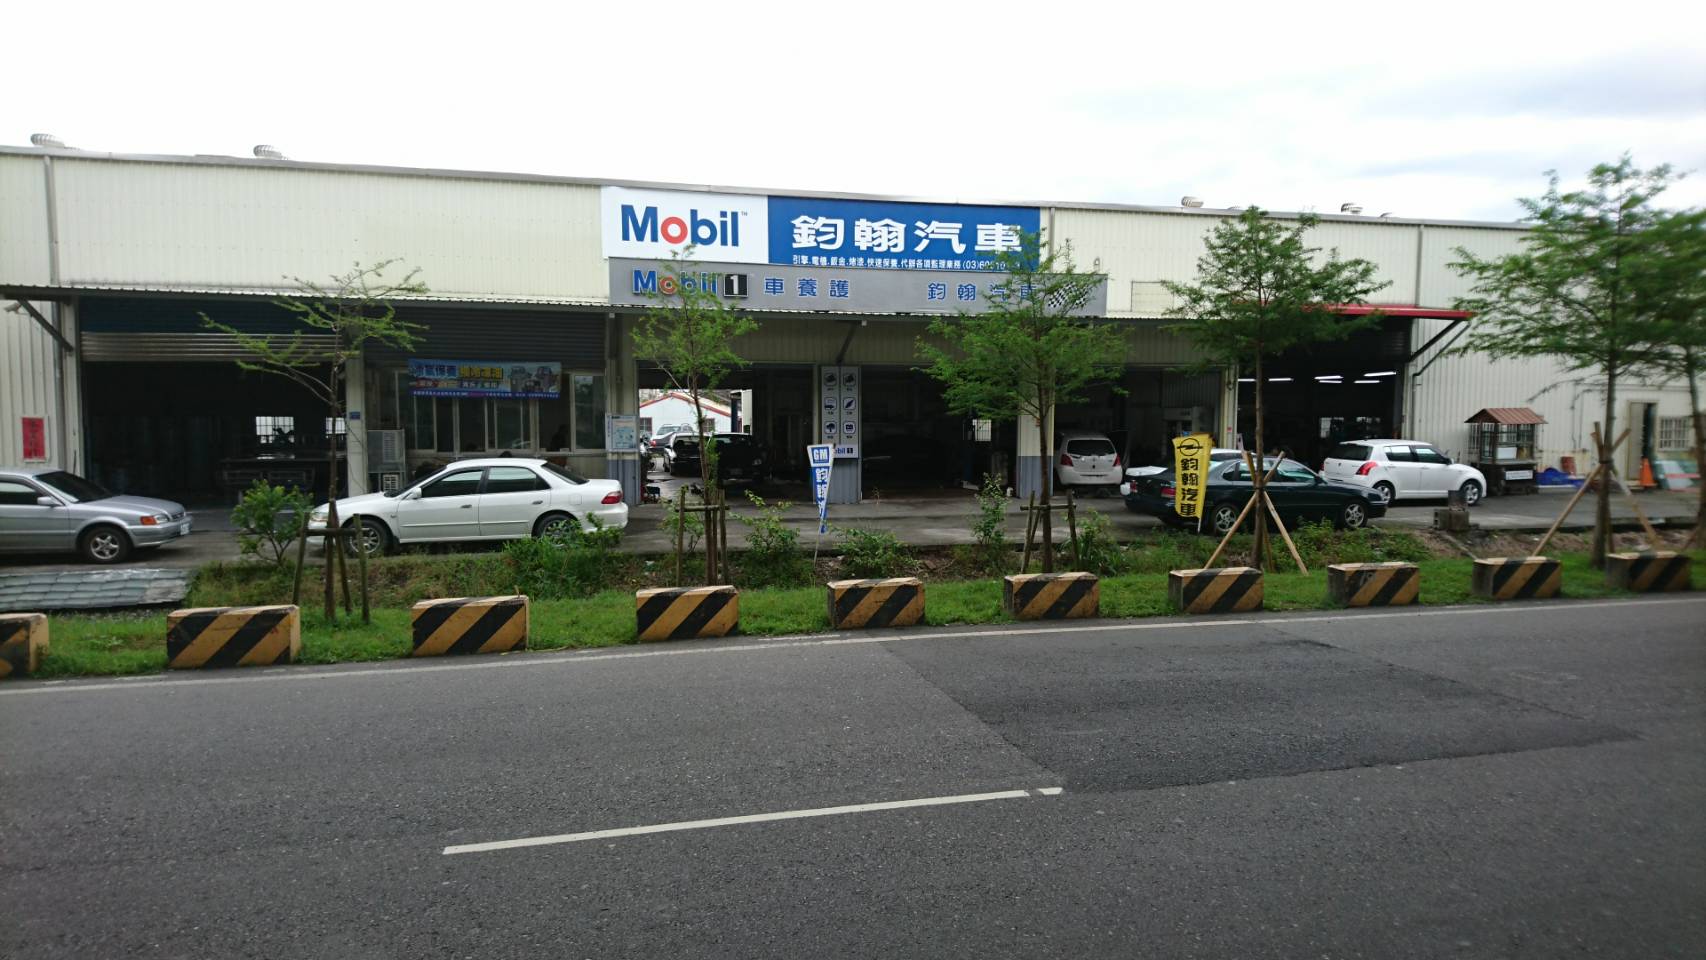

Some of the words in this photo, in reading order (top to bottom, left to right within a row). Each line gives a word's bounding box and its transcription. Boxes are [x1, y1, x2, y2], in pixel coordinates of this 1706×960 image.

[621, 204, 739, 247] Mobil
[791, 215, 1022, 255] 鈞翰汽車
[633, 268, 718, 296] Mobil
[764, 277, 849, 299] 車養護
[813, 448, 828, 461] GM
[1180, 458, 1199, 516] 鈞翰汽車
